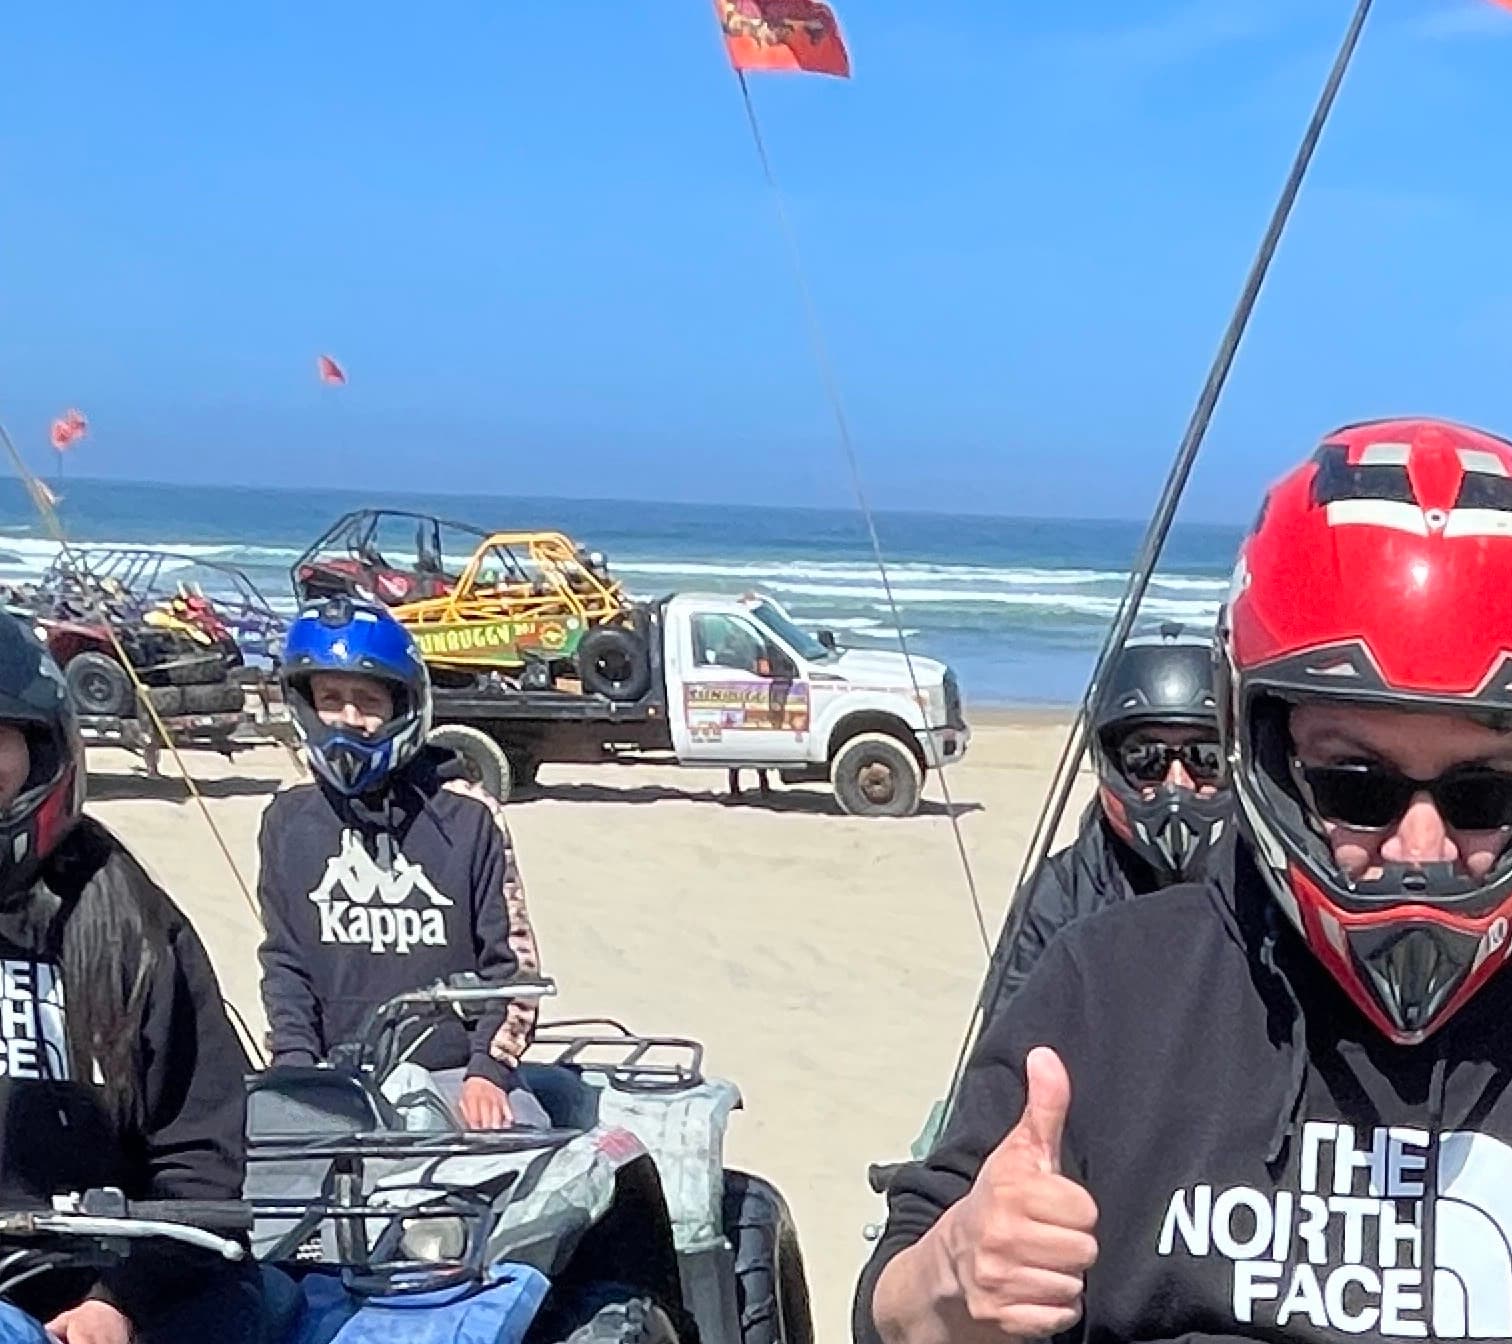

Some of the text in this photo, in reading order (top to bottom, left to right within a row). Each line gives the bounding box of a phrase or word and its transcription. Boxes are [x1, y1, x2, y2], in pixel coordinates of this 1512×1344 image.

[319, 900, 447, 953] Kappa
[1299, 1120, 1430, 1198] THE
[1157, 1183, 1424, 1268] NORTH
[1231, 1258, 1429, 1338] FACE
